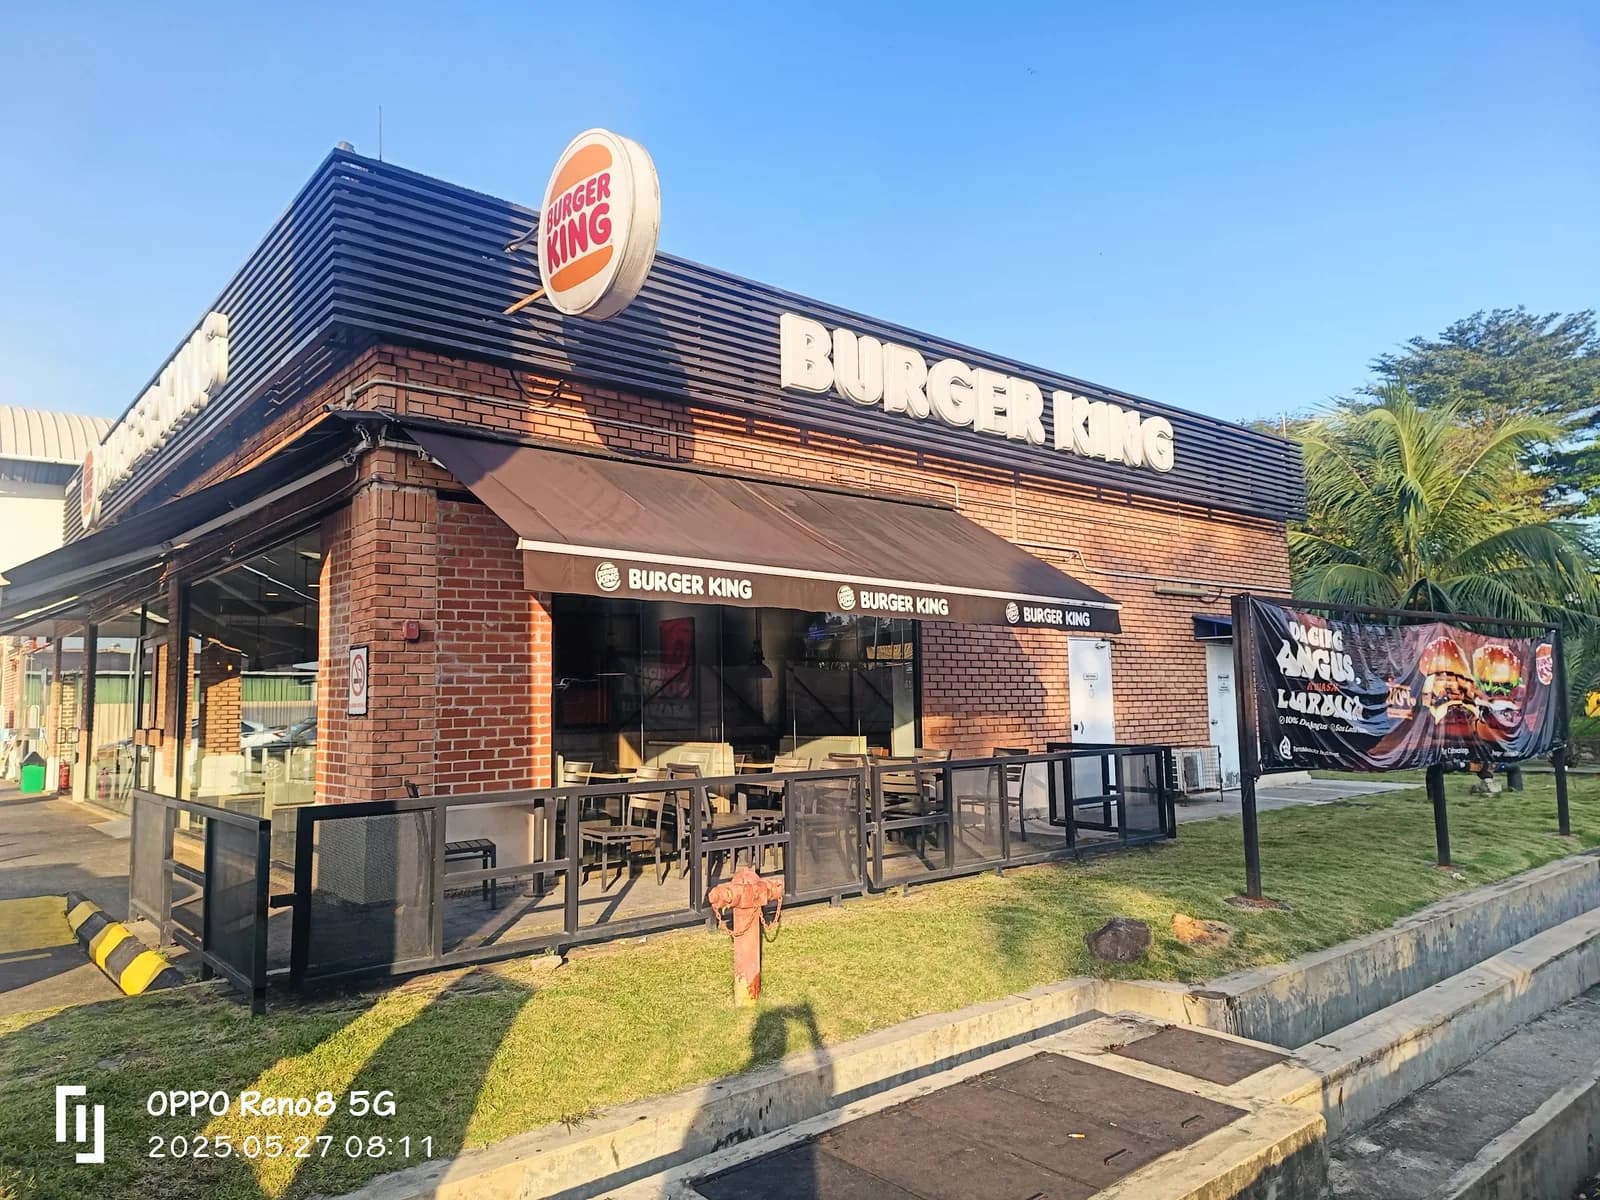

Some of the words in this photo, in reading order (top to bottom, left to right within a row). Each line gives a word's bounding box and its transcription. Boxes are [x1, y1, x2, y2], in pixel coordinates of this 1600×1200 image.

[547, 173, 610, 235] BURGER
[547, 203, 612, 274] KING
[780, 312, 1045, 446] BURGER
[1052, 389, 1175, 473] KING
[628, 568, 704, 595] BURGER
[708, 576, 752, 599] KING
[860, 591, 914, 613] BURGER
[916, 596, 949, 616] KING
[1023, 606, 1063, 625] BURGER
[1065, 610, 1091, 627] KING
